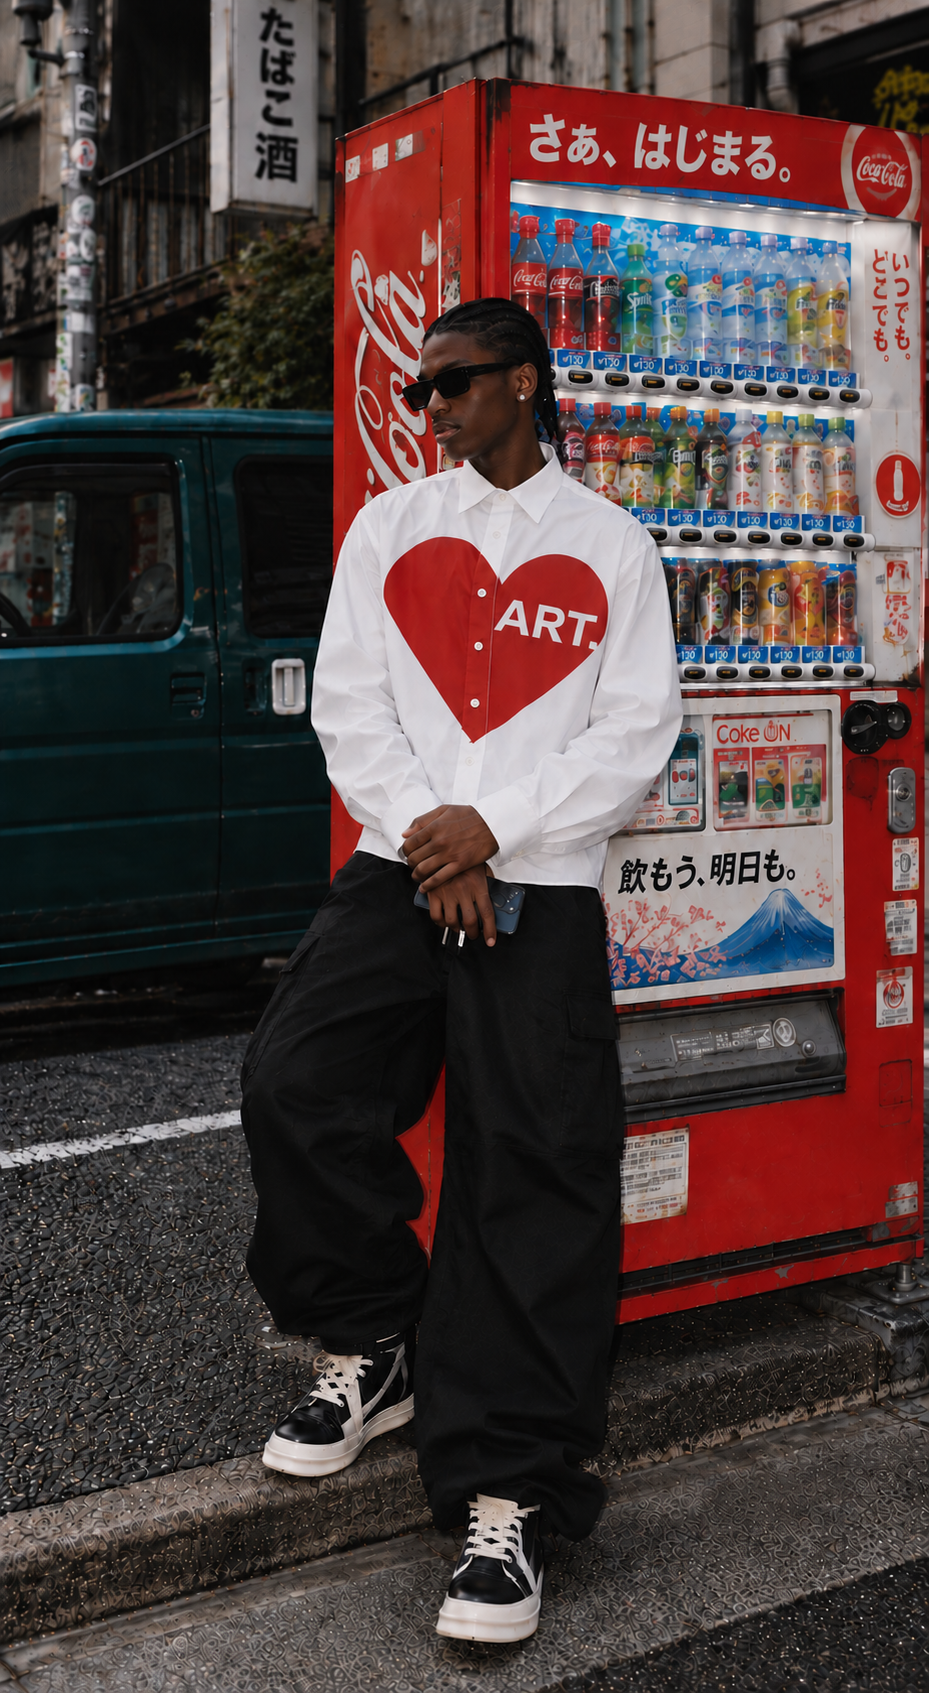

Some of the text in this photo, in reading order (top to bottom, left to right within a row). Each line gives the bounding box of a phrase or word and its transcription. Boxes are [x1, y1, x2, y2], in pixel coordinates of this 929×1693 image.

[255, 7, 298, 183] たばこ酒
[892, 252, 911, 360] いつでも。
[494, 599, 598, 651] ART.
[716, 724, 760, 744] Coke
[618, 849, 796, 894] 飲もう、明日も。
